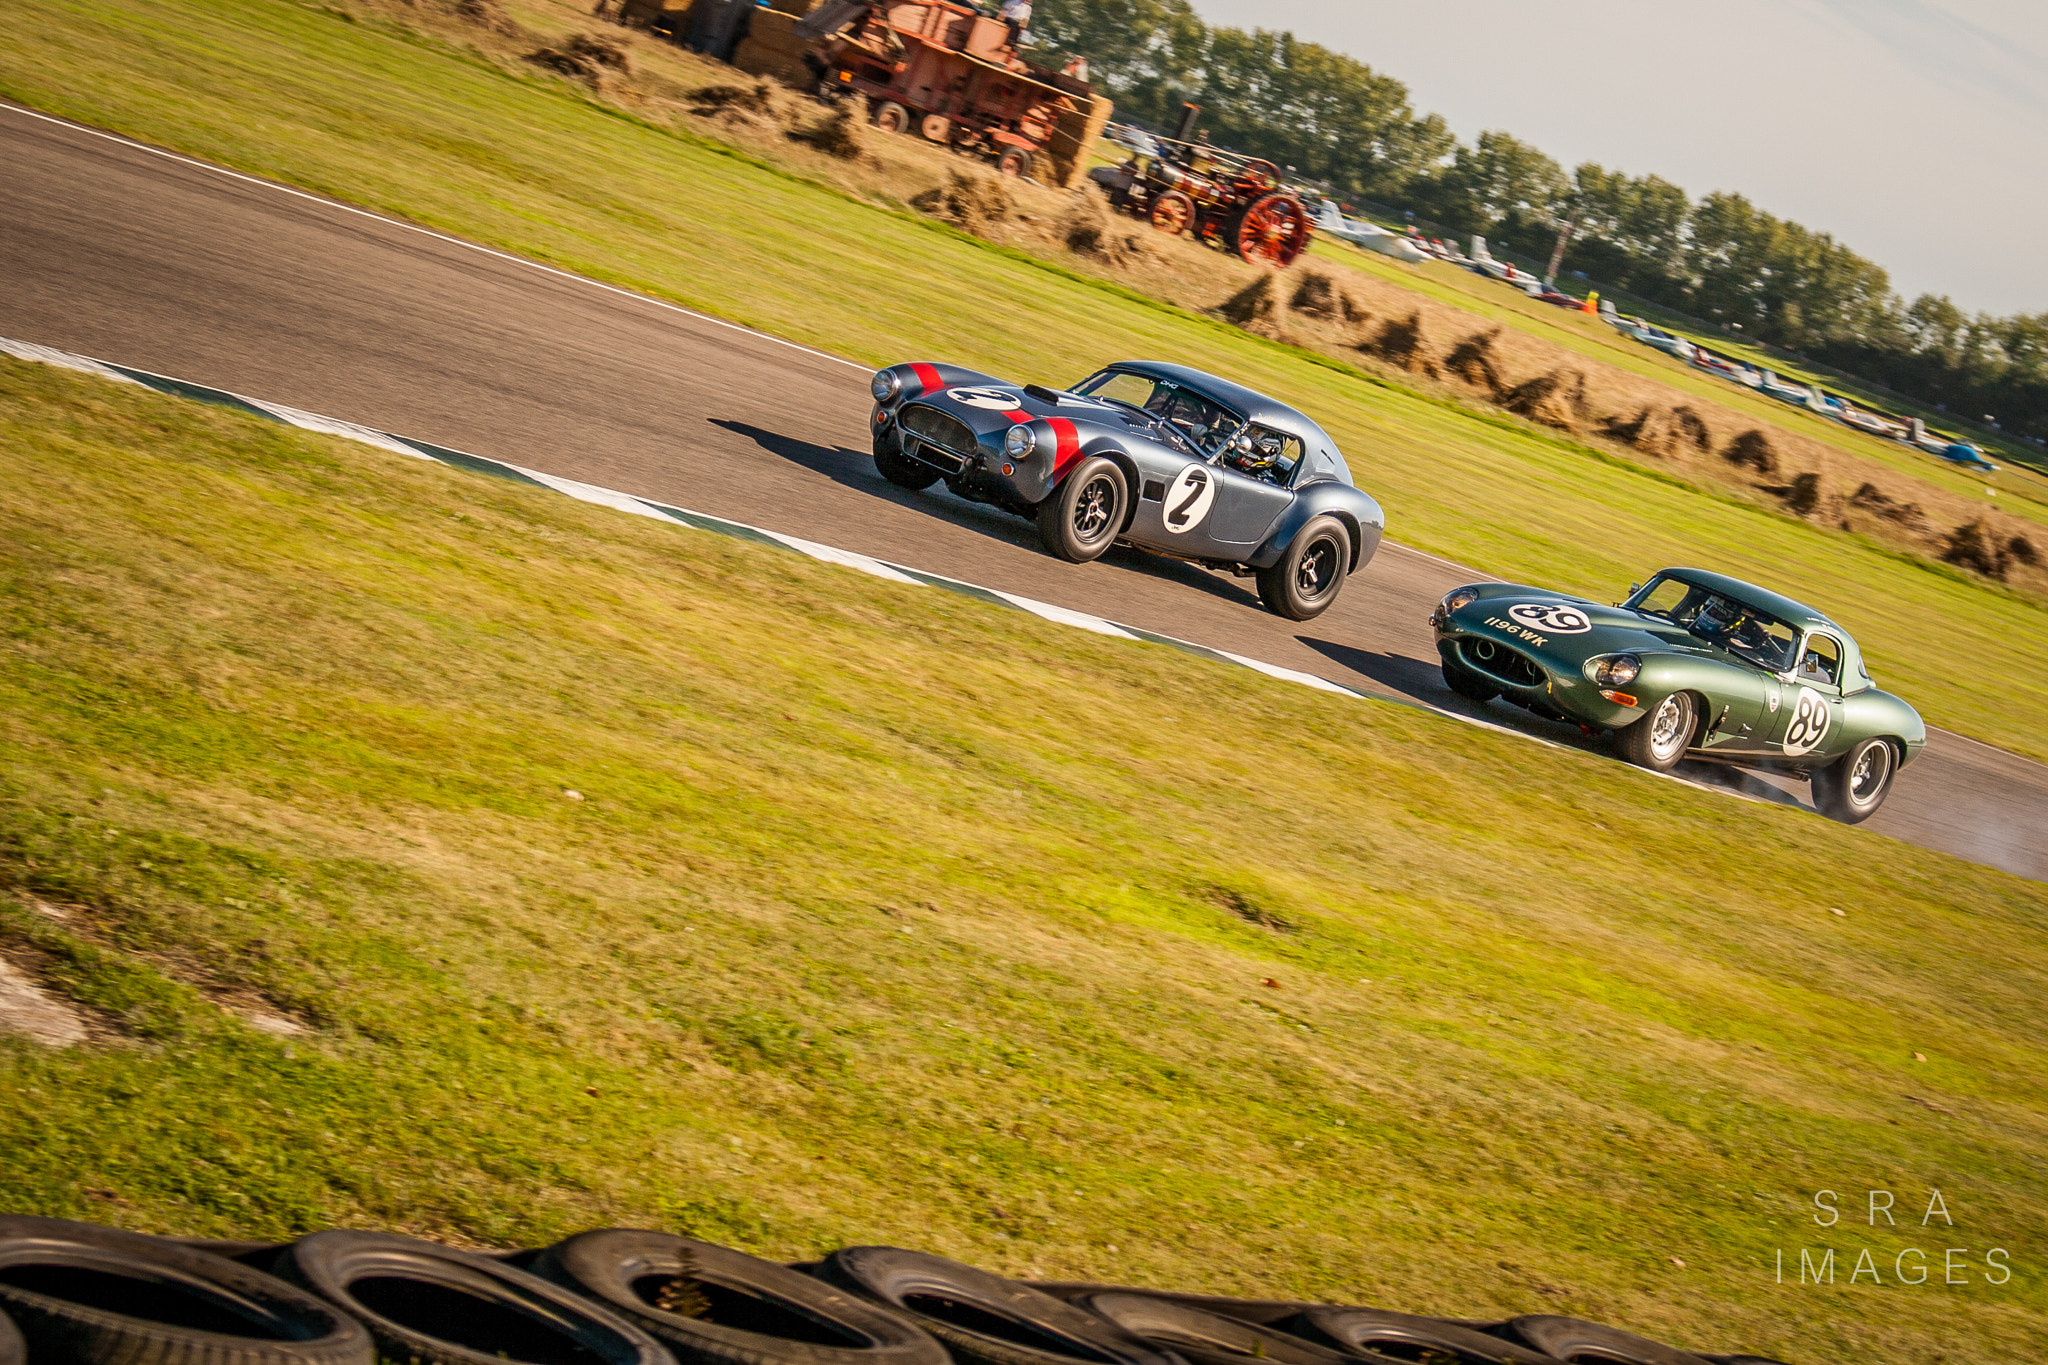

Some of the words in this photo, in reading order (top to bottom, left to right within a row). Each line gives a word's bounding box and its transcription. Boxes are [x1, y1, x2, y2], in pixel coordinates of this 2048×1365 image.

[1168, 469, 1207, 526] 2
[1513, 606, 1588, 631] 89
[1787, 696, 1828, 748] 89
